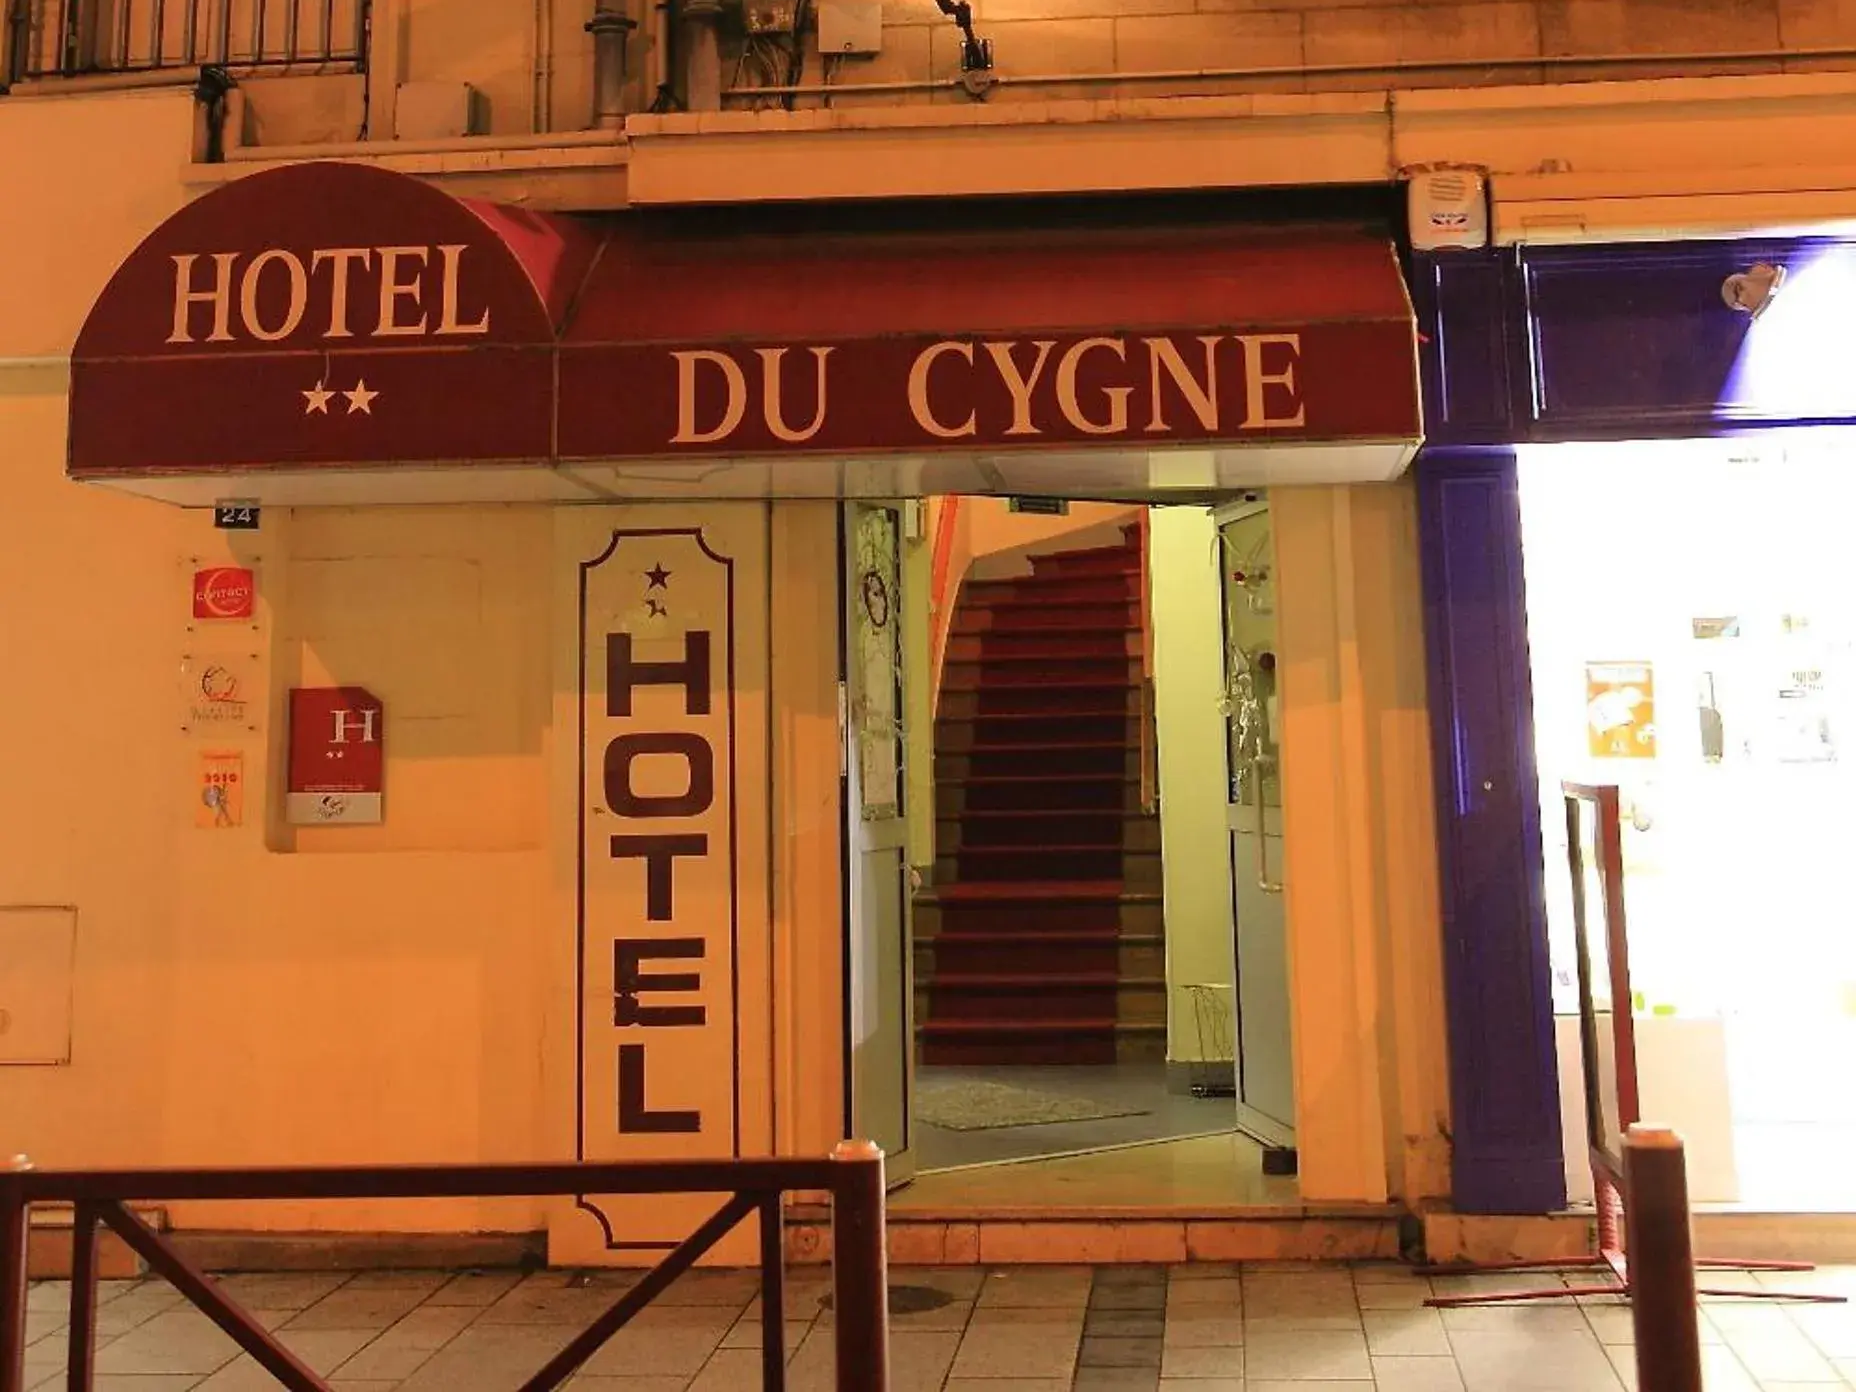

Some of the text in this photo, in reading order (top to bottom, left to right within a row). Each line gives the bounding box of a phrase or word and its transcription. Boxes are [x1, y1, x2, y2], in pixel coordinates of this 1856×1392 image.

[165, 244, 489, 343] HOTEL
[669, 333, 1305, 443] DU CYGNE
[221, 506, 252, 523] 24
[327, 708, 379, 744] H
[603, 630, 714, 1134] HOTEL
